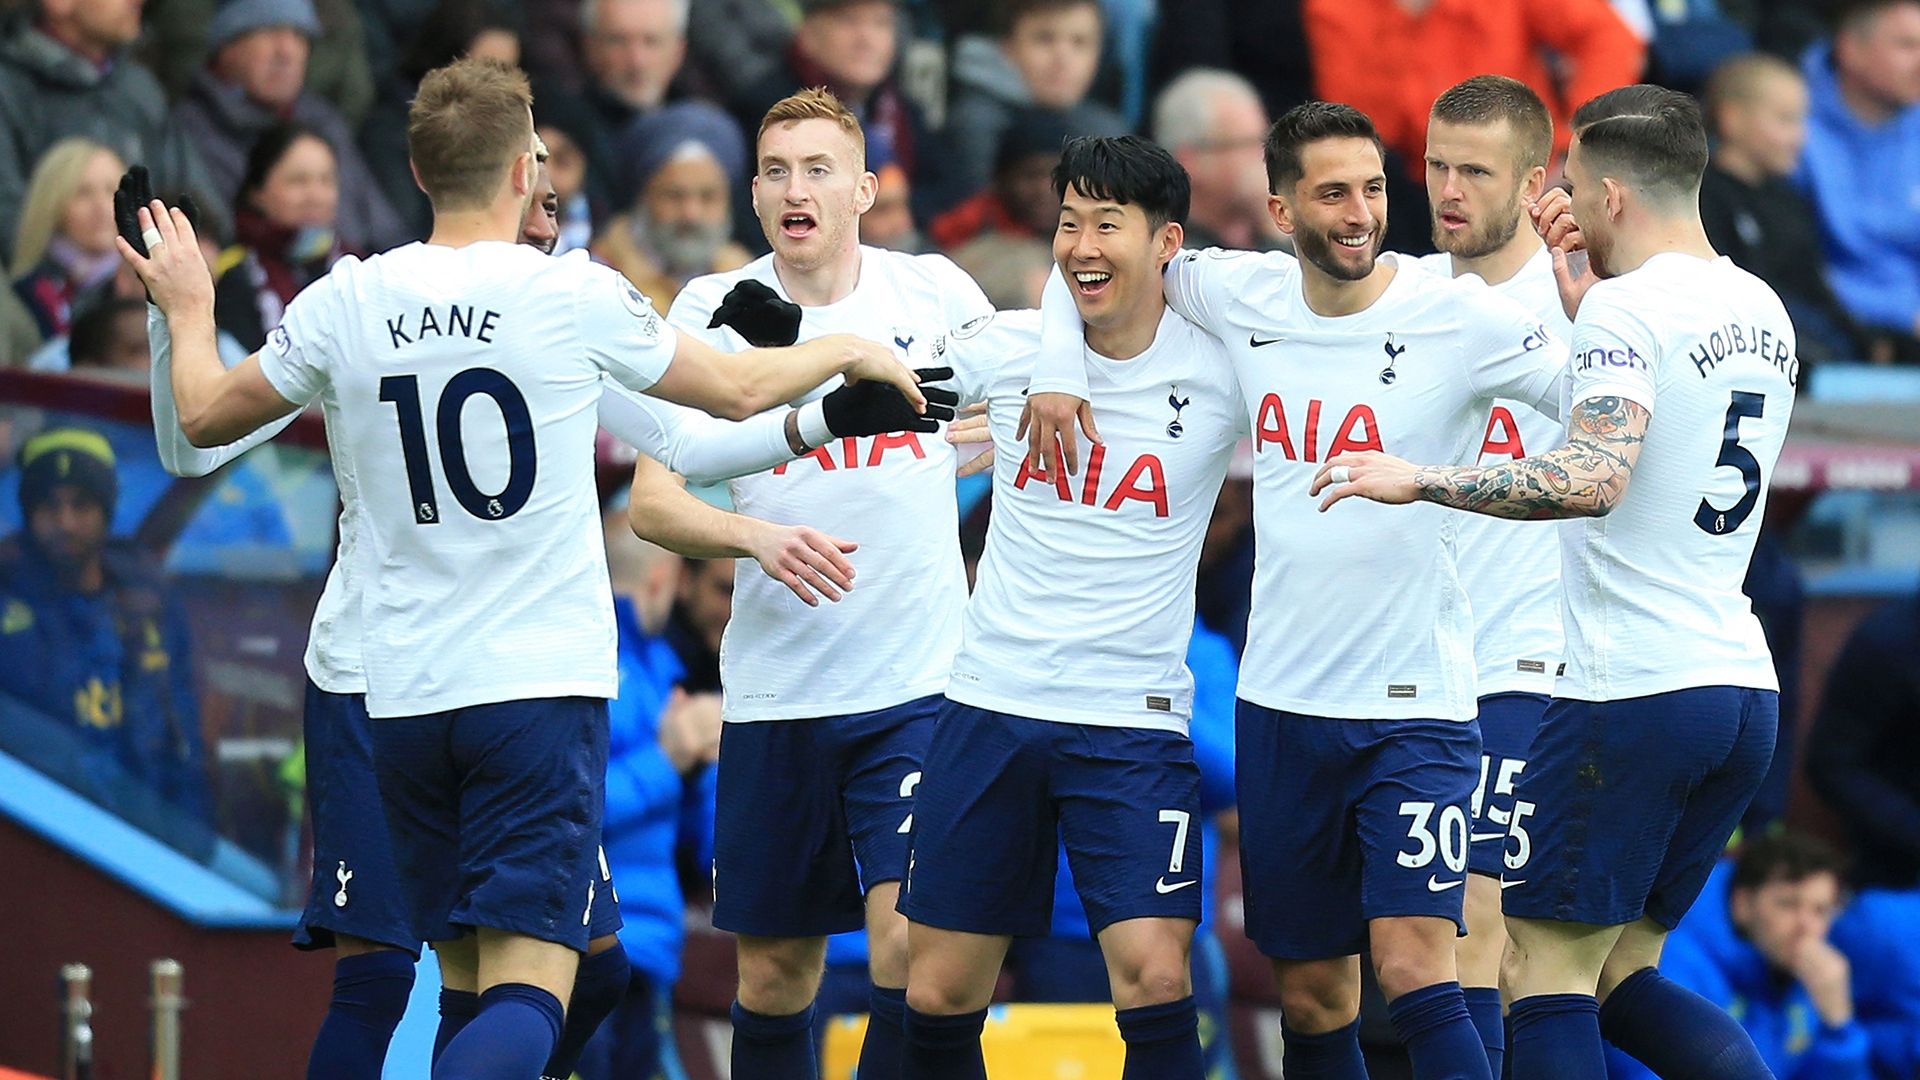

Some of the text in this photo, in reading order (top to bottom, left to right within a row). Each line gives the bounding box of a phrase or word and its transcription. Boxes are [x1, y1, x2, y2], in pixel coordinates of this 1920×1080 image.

[387, 305, 501, 349] KANE
[379, 367, 537, 524] 10
[1256, 393, 1384, 463] AIA
[1693, 390, 1766, 535] 5
[1014, 437, 1169, 517] AIA
[1159, 810, 1190, 872] 7
[1396, 802, 1467, 873] 30
[1503, 801, 1536, 869] 5
